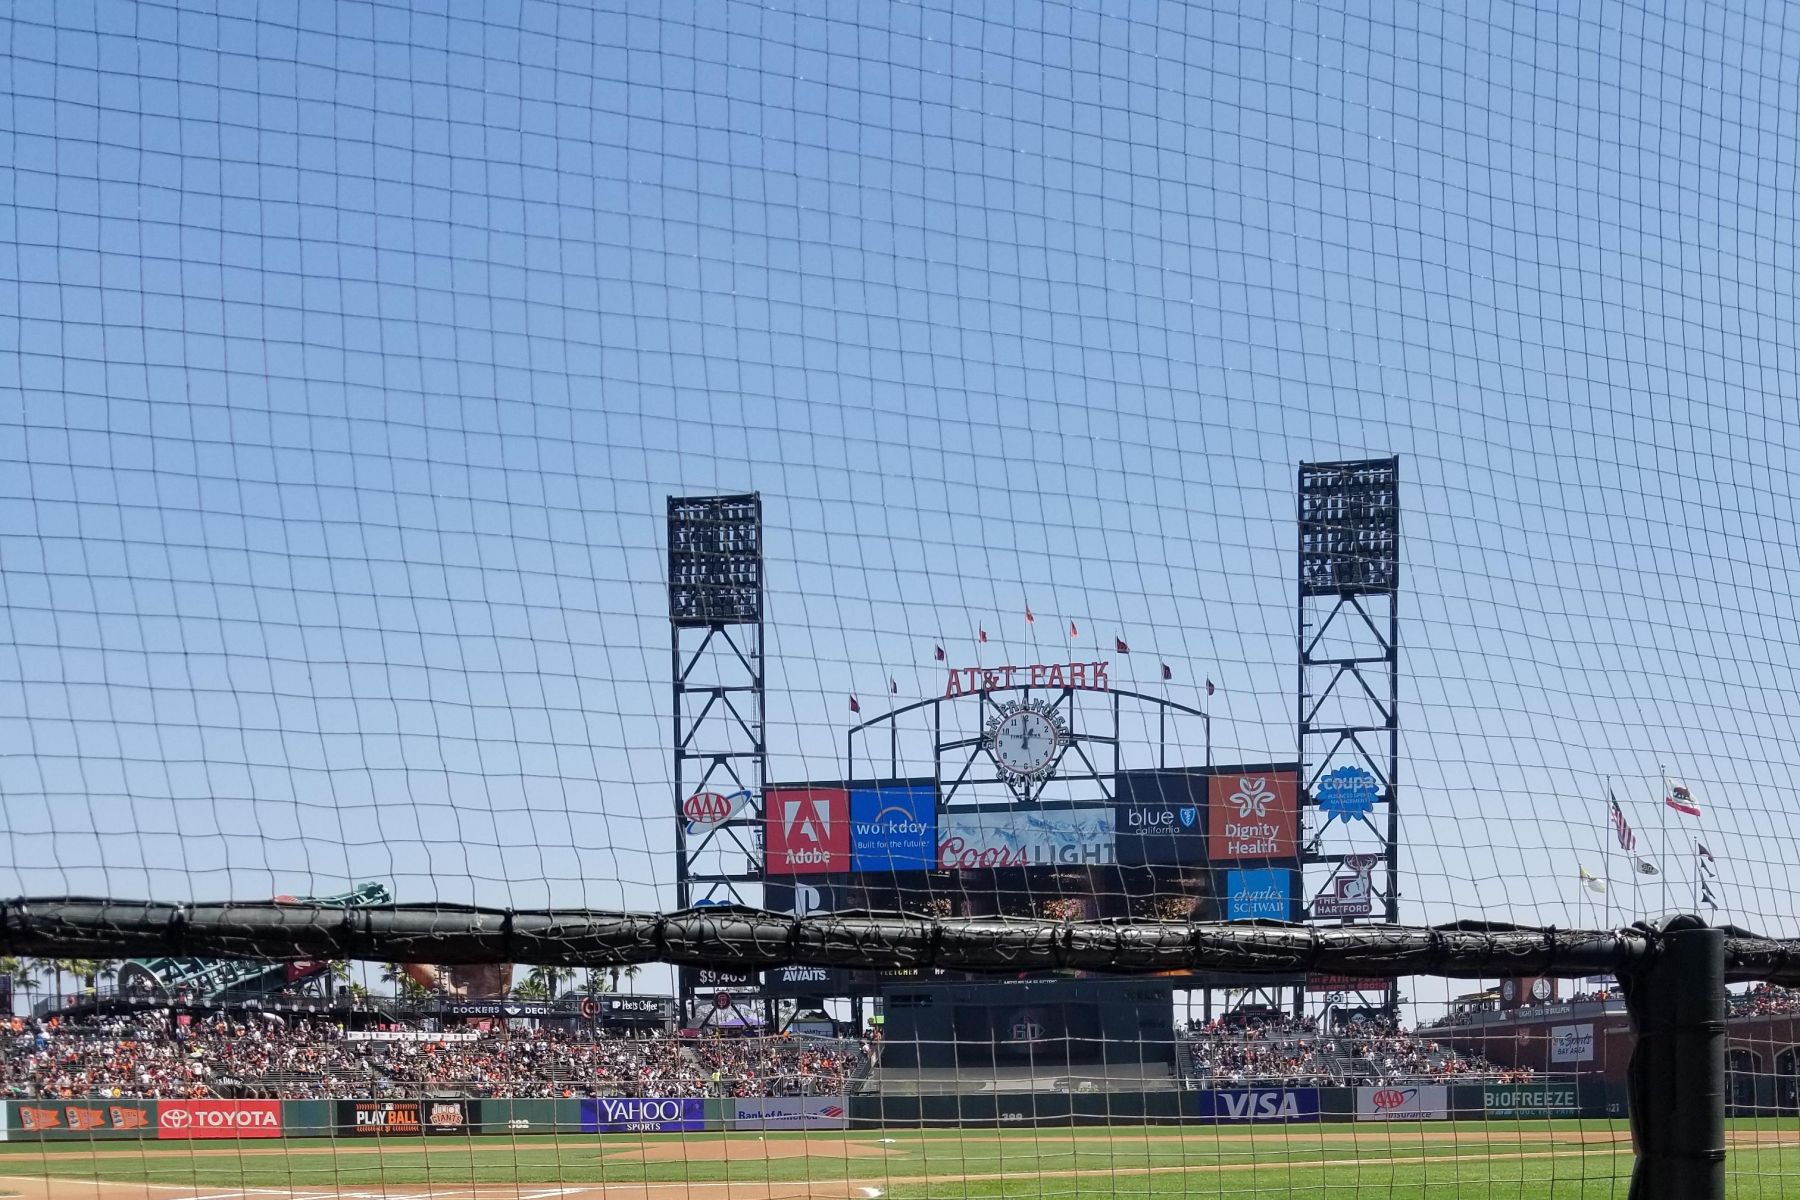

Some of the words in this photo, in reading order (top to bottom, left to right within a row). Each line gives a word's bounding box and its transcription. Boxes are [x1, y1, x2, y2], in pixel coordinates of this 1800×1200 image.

[945, 665, 1017, 699] AT&T
[1030, 661, 1109, 692] PARK
[982, 714, 1001, 750] SAN
[996, 764, 1057, 787] GIANTS
[1323, 776, 1374, 792] coupa
[688, 793, 728, 823] AAA
[1128, 808, 1175, 826] blue
[856, 819, 928, 837] workday
[1135, 825, 1180, 835] california
[1225, 822, 1280, 840] Dignity
[889, 839, 902, 848] the
[1228, 841, 1278, 854] Health
[785, 847, 831, 864] Adobe
[938, 836, 1030, 869] Coors
[1034, 842, 1115, 866] LIGHT
[1233, 886, 1284, 901] charles
[1318, 896, 1336, 905] THE
[1233, 901, 1284, 913] SCHWAB
[1317, 904, 1370, 914] HARTFORD
[452, 1006, 500, 1014] DOCKERS
[639, 1001, 658, 1012] Coffee
[1218, 1092, 1300, 1119] VISA
[1375, 1090, 1401, 1107] AAA
[195, 1110, 278, 1126] TOYOTA
[356, 1110, 388, 1125] PLAY
[388, 1110, 418, 1124] BALL
[602, 1100, 682, 1121] YAHOO!
[738, 1110, 763, 1120] Bank
[431, 1114, 462, 1124] GIANTS
[626, 1123, 661, 1131] SPORTS
